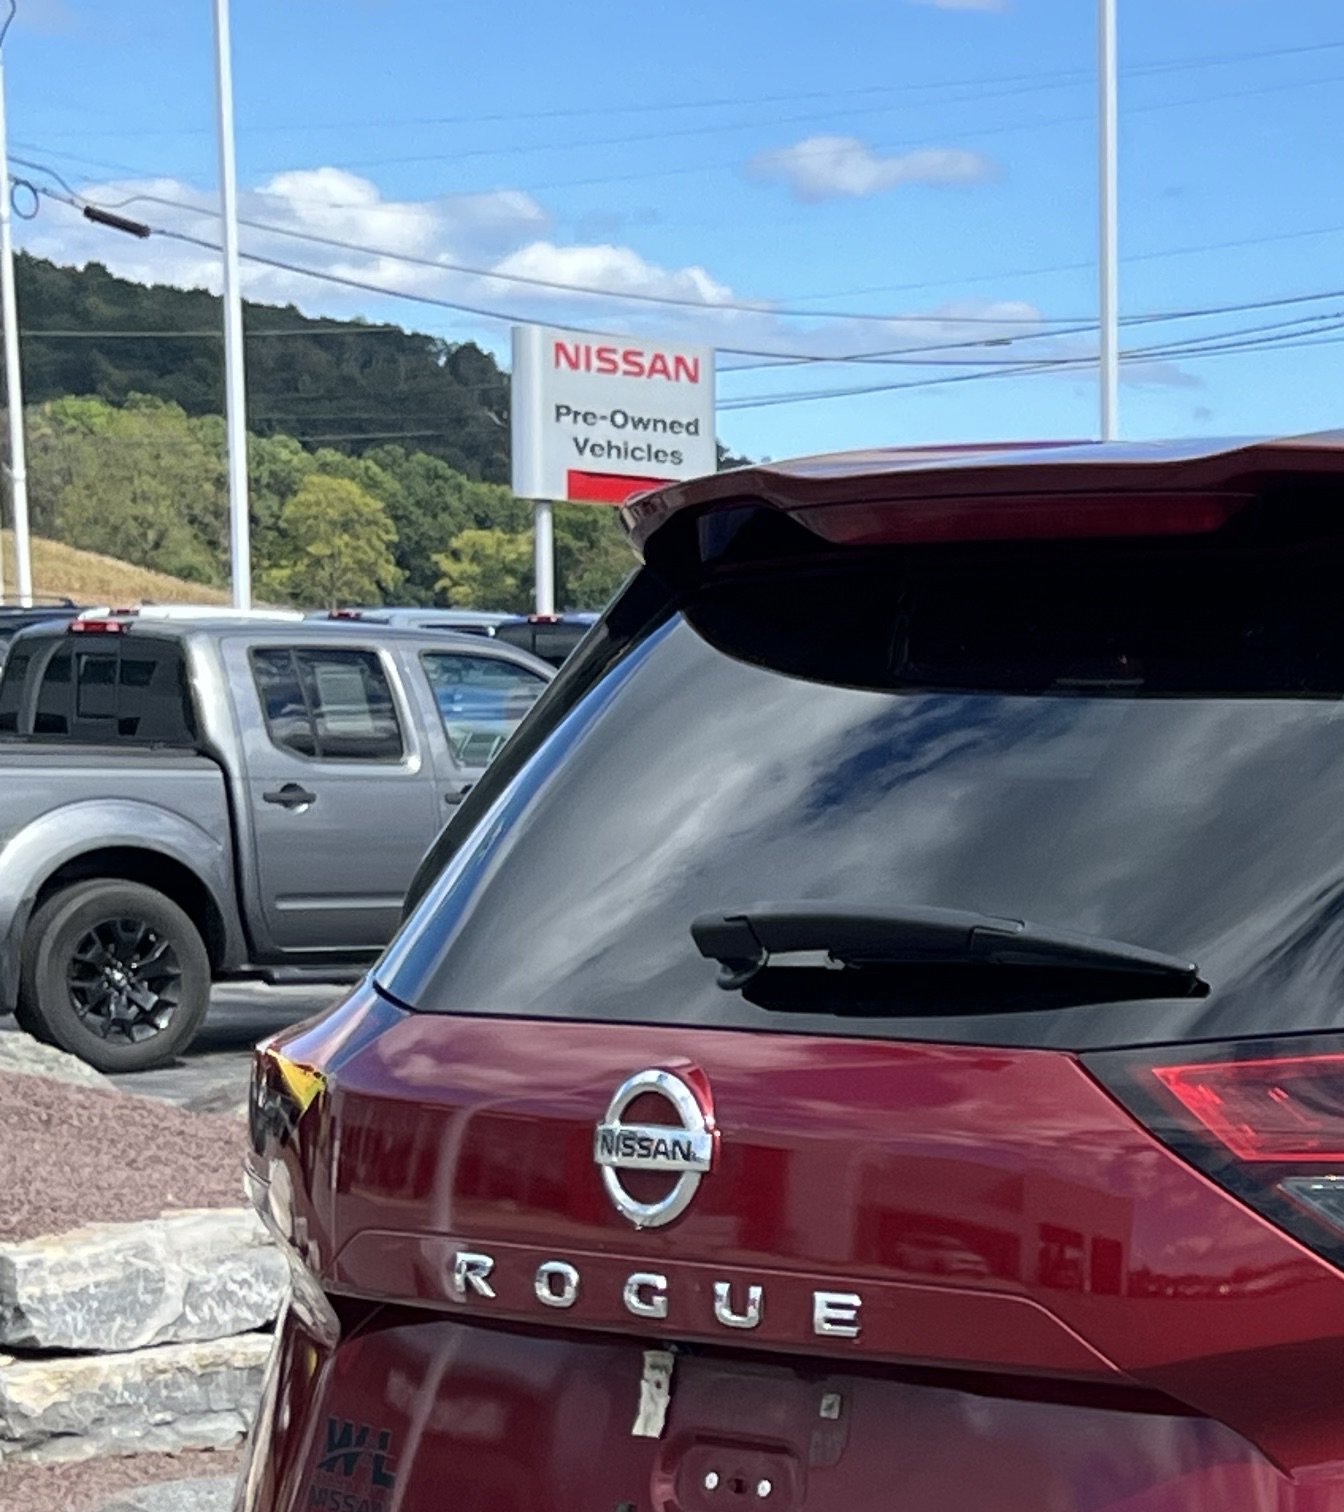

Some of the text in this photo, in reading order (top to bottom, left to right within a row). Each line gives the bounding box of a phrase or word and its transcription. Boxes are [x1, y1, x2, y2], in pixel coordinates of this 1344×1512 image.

[553, 341, 700, 384] NISSAN
[554, 403, 700, 436] Pre-Owned
[572, 436, 684, 465] Vehicles
[601, 1132, 693, 1162] NISSAN
[454, 1251, 862, 1338] ROGUE
